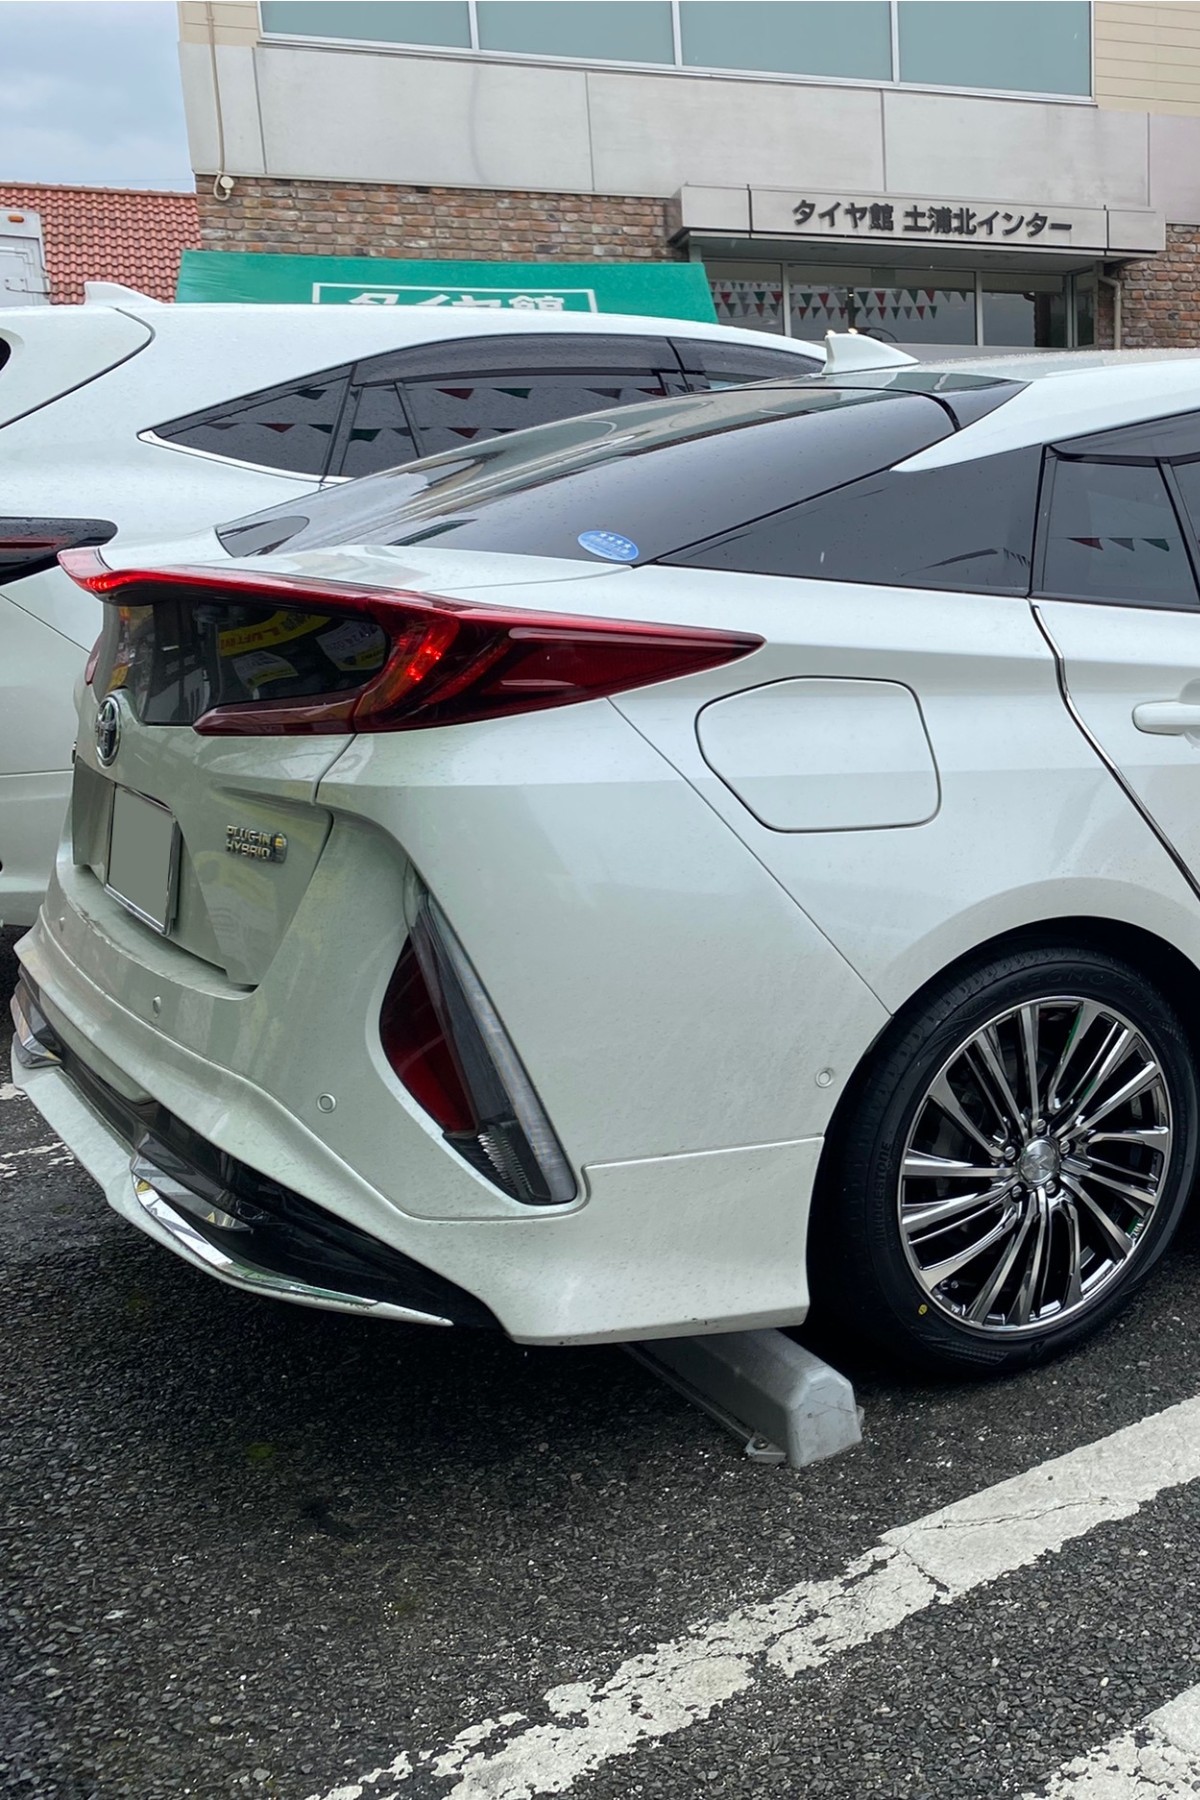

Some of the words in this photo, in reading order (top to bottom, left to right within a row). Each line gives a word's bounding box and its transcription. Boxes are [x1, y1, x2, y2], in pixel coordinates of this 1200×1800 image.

[793, 199, 895, 232] タイヤ館
[903, 205, 1073, 238] 土浦北インター
[226, 825, 271, 845] PLUG-IN
[226, 838, 270, 859] HYBRID
